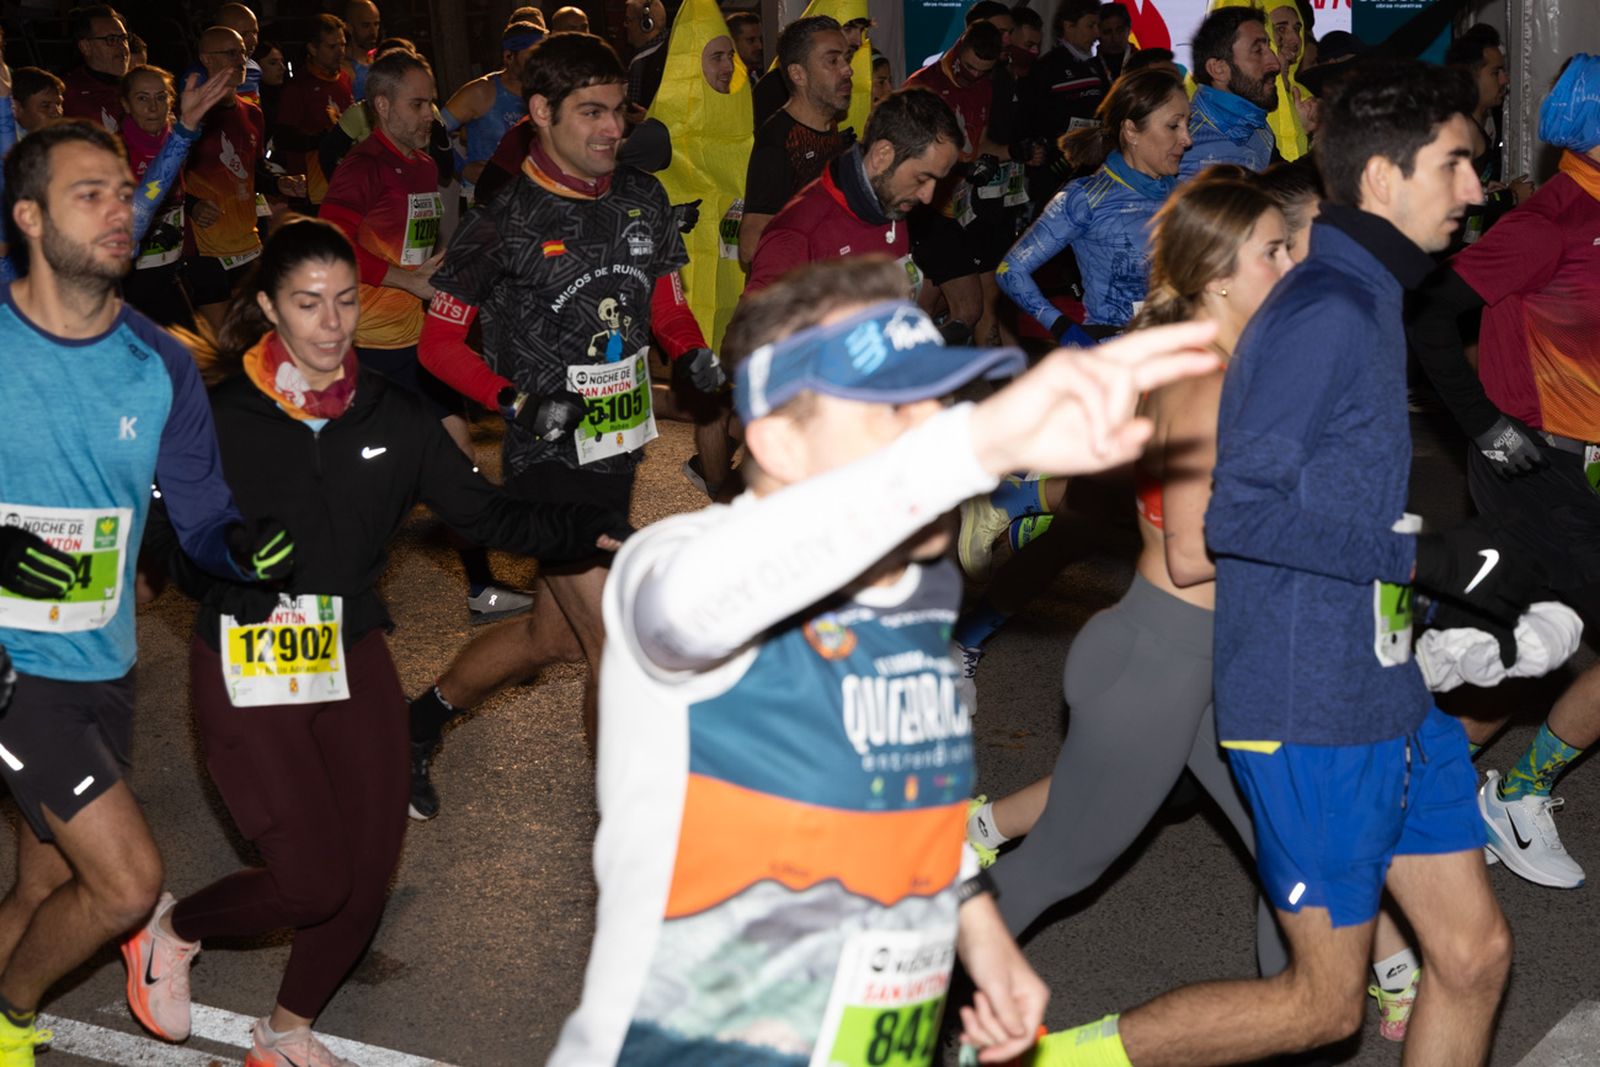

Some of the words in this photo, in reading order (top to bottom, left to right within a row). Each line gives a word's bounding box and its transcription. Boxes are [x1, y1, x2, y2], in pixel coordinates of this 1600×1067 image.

[551, 273, 592, 313] AMIGOS
[594, 267, 608, 278] DE
[589, 371, 618, 384] NOCHE
[620, 368, 631, 379] DE
[588, 388, 642, 426] 5105
[119, 416, 138, 439] K
[23, 521, 65, 534] NOCHE
[68, 523, 84, 535] DE
[240, 625, 333, 663] 12902
